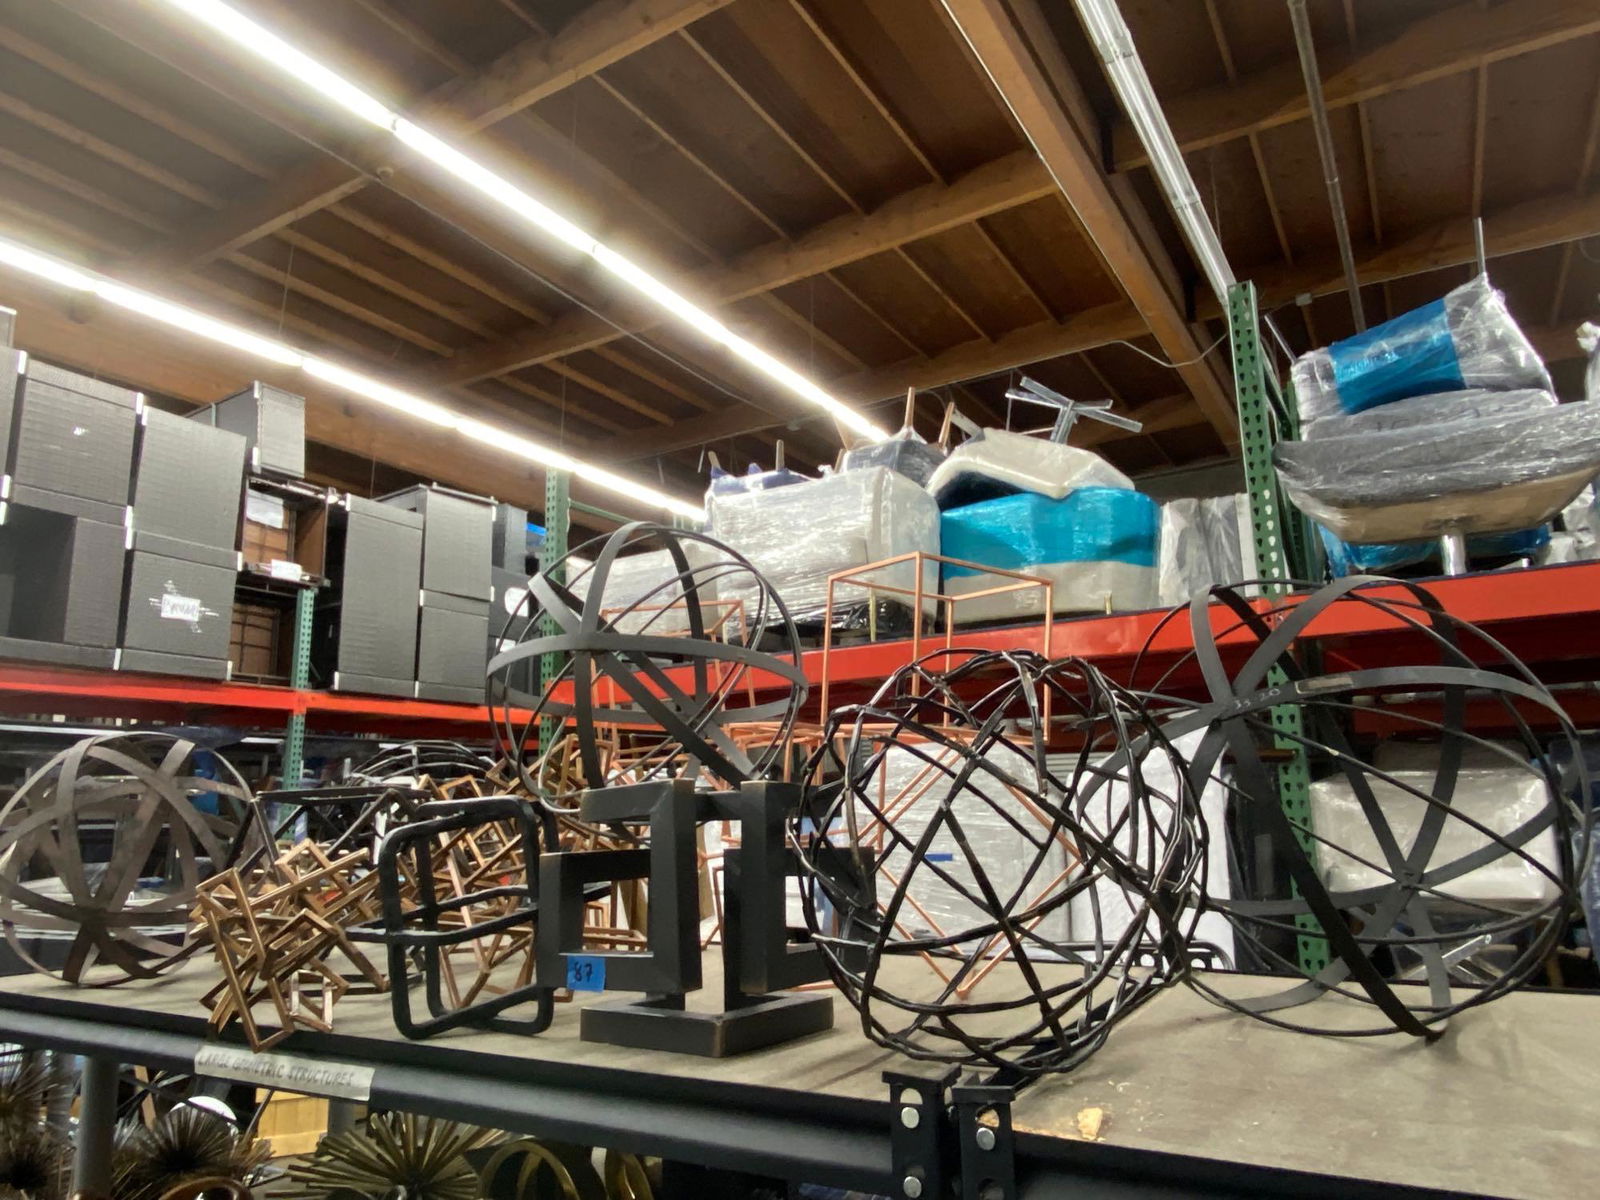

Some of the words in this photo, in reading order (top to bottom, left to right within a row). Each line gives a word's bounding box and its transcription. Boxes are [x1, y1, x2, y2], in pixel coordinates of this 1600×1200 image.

[573, 960, 593, 983] 87
[197, 1053, 228, 1069] LARGE
[287, 1065, 355, 1086] STRUCTURES
